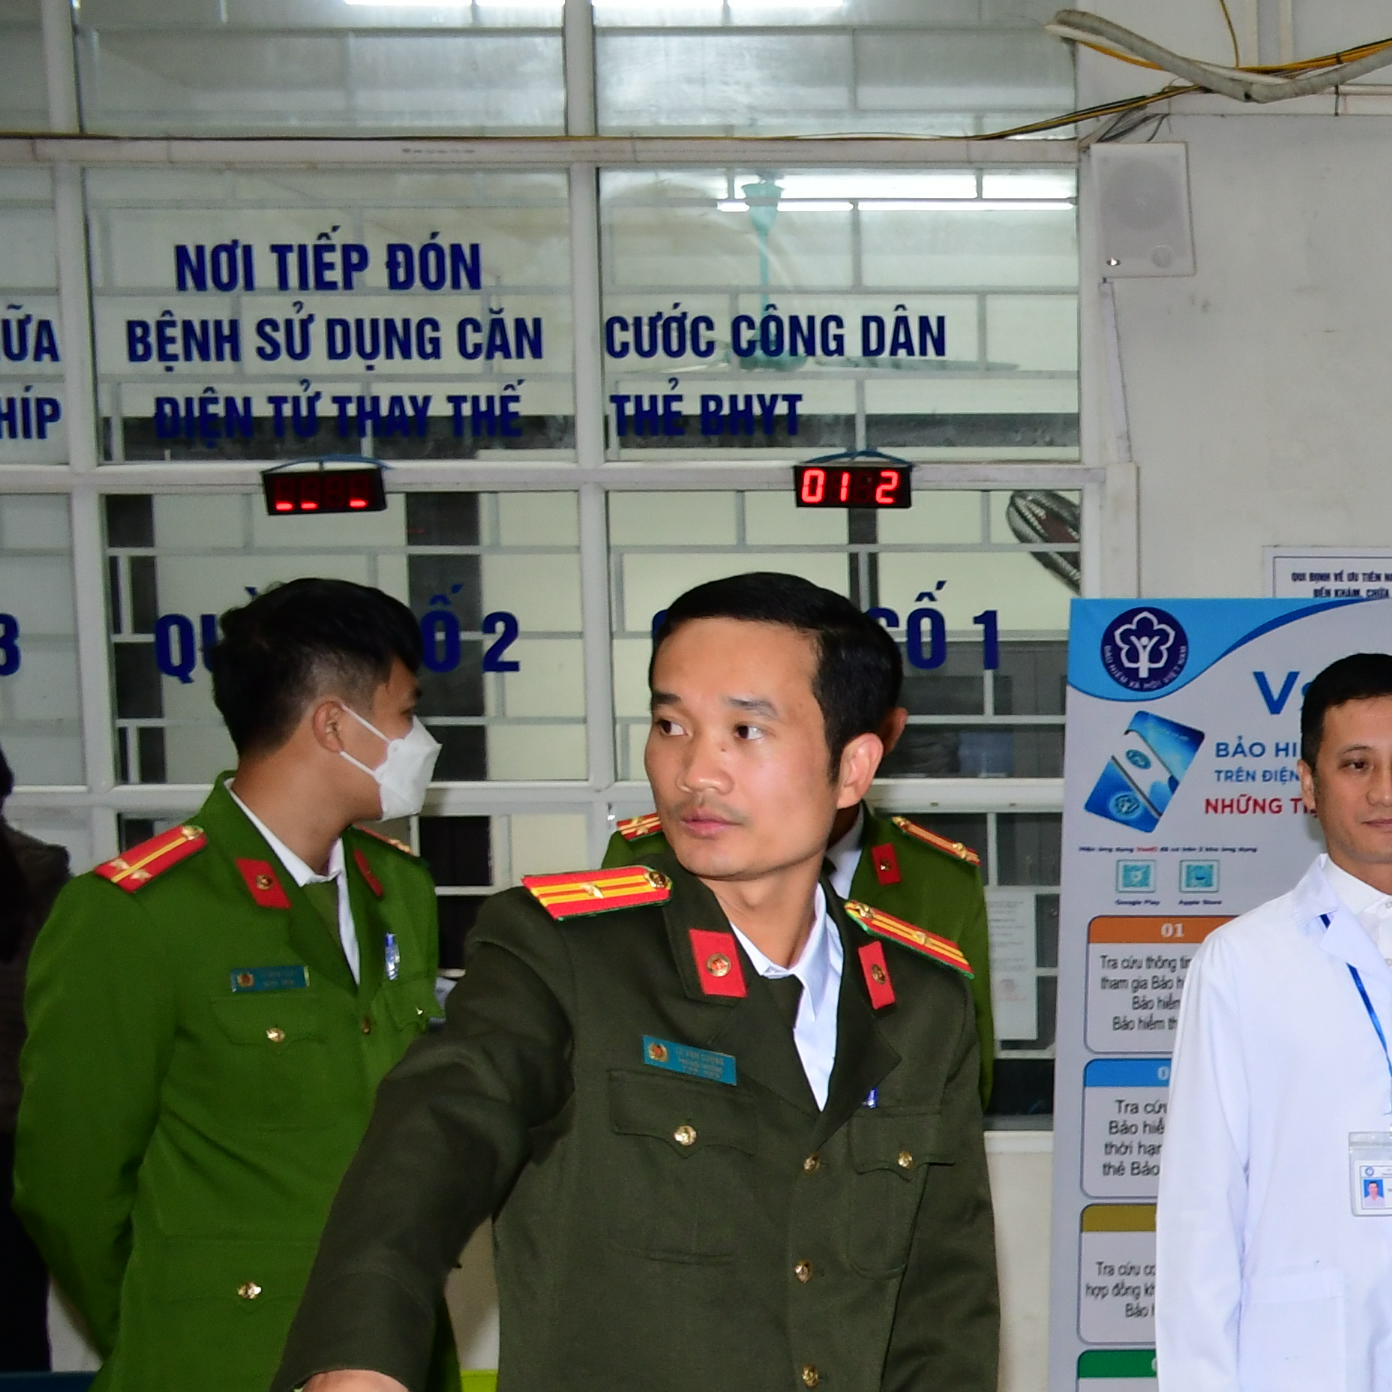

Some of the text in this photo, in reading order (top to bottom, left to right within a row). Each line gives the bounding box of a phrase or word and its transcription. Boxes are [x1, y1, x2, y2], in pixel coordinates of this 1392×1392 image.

[174, 225, 483, 292] NƠI TIẾP ĐÓN
[126, 301, 544, 371] BỆNH SỬ DỤNG CĂN
[604, 302, 946, 359] CƯỚC CÔNG DÂN
[154, 379, 527, 448] ĐIỆN TỬ THAY THẾ
[610, 377, 803, 437] THẺ BHYT
[421, 584, 521, 673] Ố 2
[973, 609, 999, 670] 1
[1214, 766, 1256, 782] TRÊN
[1215, 735, 1266, 758] BẢO
[1204, 794, 1283, 814] NHỮNG
[1161, 923, 1184, 938] 01
[1109, 1118, 1165, 1135] Bảo hiể
[1115, 1099, 1139, 1114] Tra
